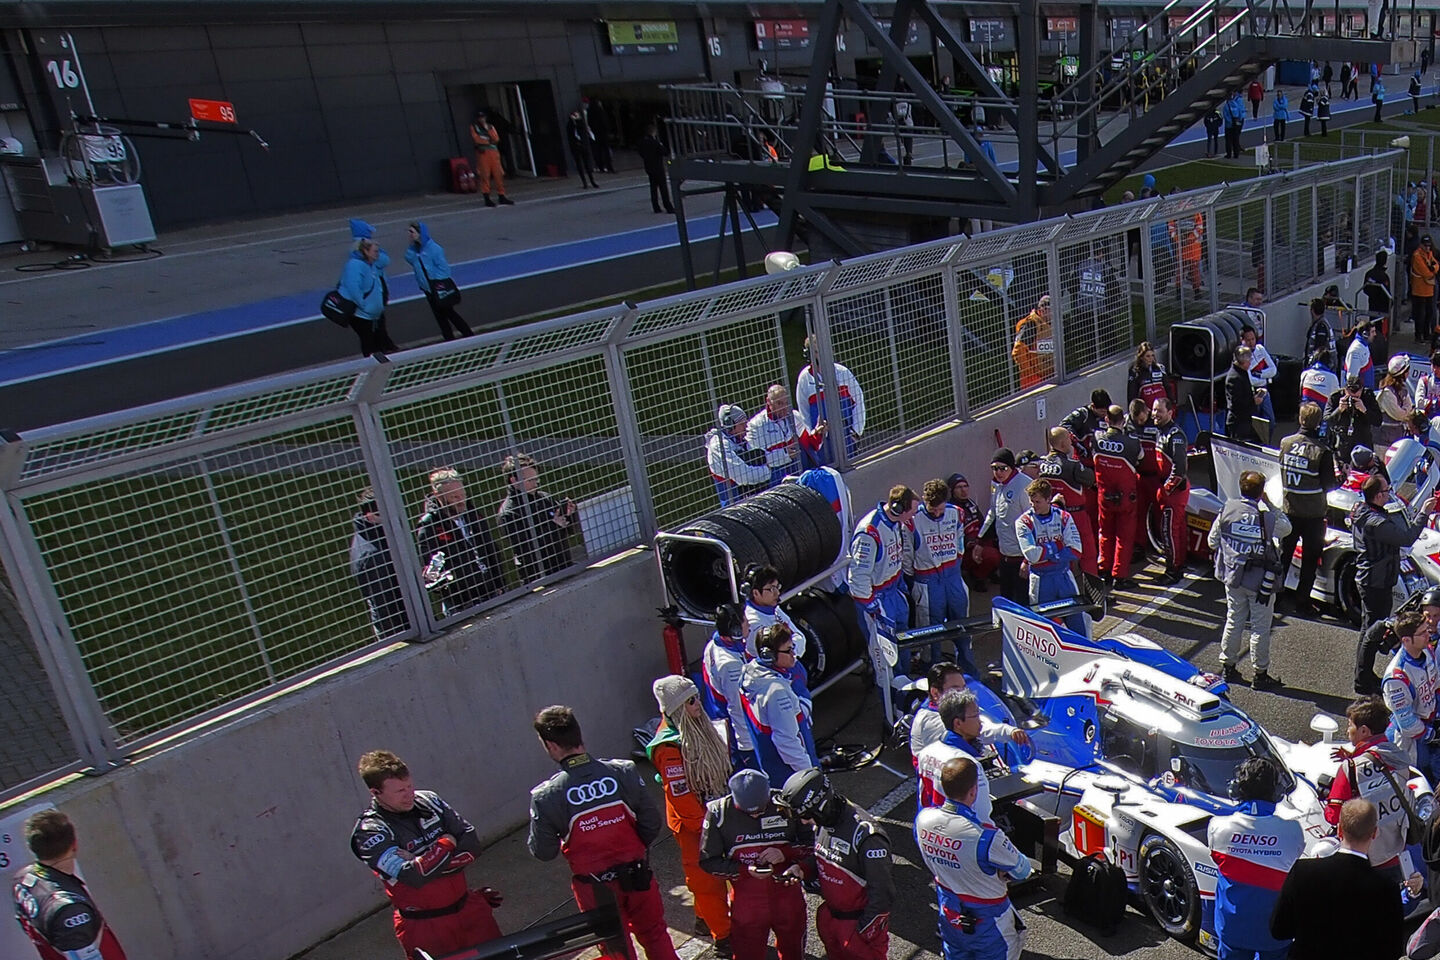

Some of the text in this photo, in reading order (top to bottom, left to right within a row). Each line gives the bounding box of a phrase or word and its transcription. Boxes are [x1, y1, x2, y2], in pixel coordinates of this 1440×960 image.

[708, 37, 721, 56] 15
[836, 34, 846, 52] 14
[47, 60, 79, 89] 16
[219, 105, 235, 122] 95
[1411, 369, 1428, 379] DEN
[1290, 443, 1305, 456] 24
[1286, 471, 1302, 487] TV
[1240, 513, 1255, 526] 31
[926, 532, 956, 545] DENSO
[929, 541, 956, 552] TOYOTA
[1191, 532, 1203, 552] 7
[1016, 626, 1058, 658] DENSO
[1015, 643, 1036, 659] TOYOTA
[1209, 720, 1249, 737] DENSO
[1194, 737, 1238, 746] TOYOTA
[1165, 774, 1172, 784] E
[579, 815, 599, 827] Audi
[580, 812, 626, 833] Top Service
[744, 831, 786, 841] Audi Sport
[920, 828, 963, 851] DENSO
[1077, 820, 1088, 852] 1
[1230, 833, 1278, 847] DENSO
[923, 843, 960, 863] TOYOTA
[1119, 848, 1133, 869] P1
[1227, 846, 1282, 857] TOYOTA HYBRID
[925, 854, 961, 870] HYBRID
